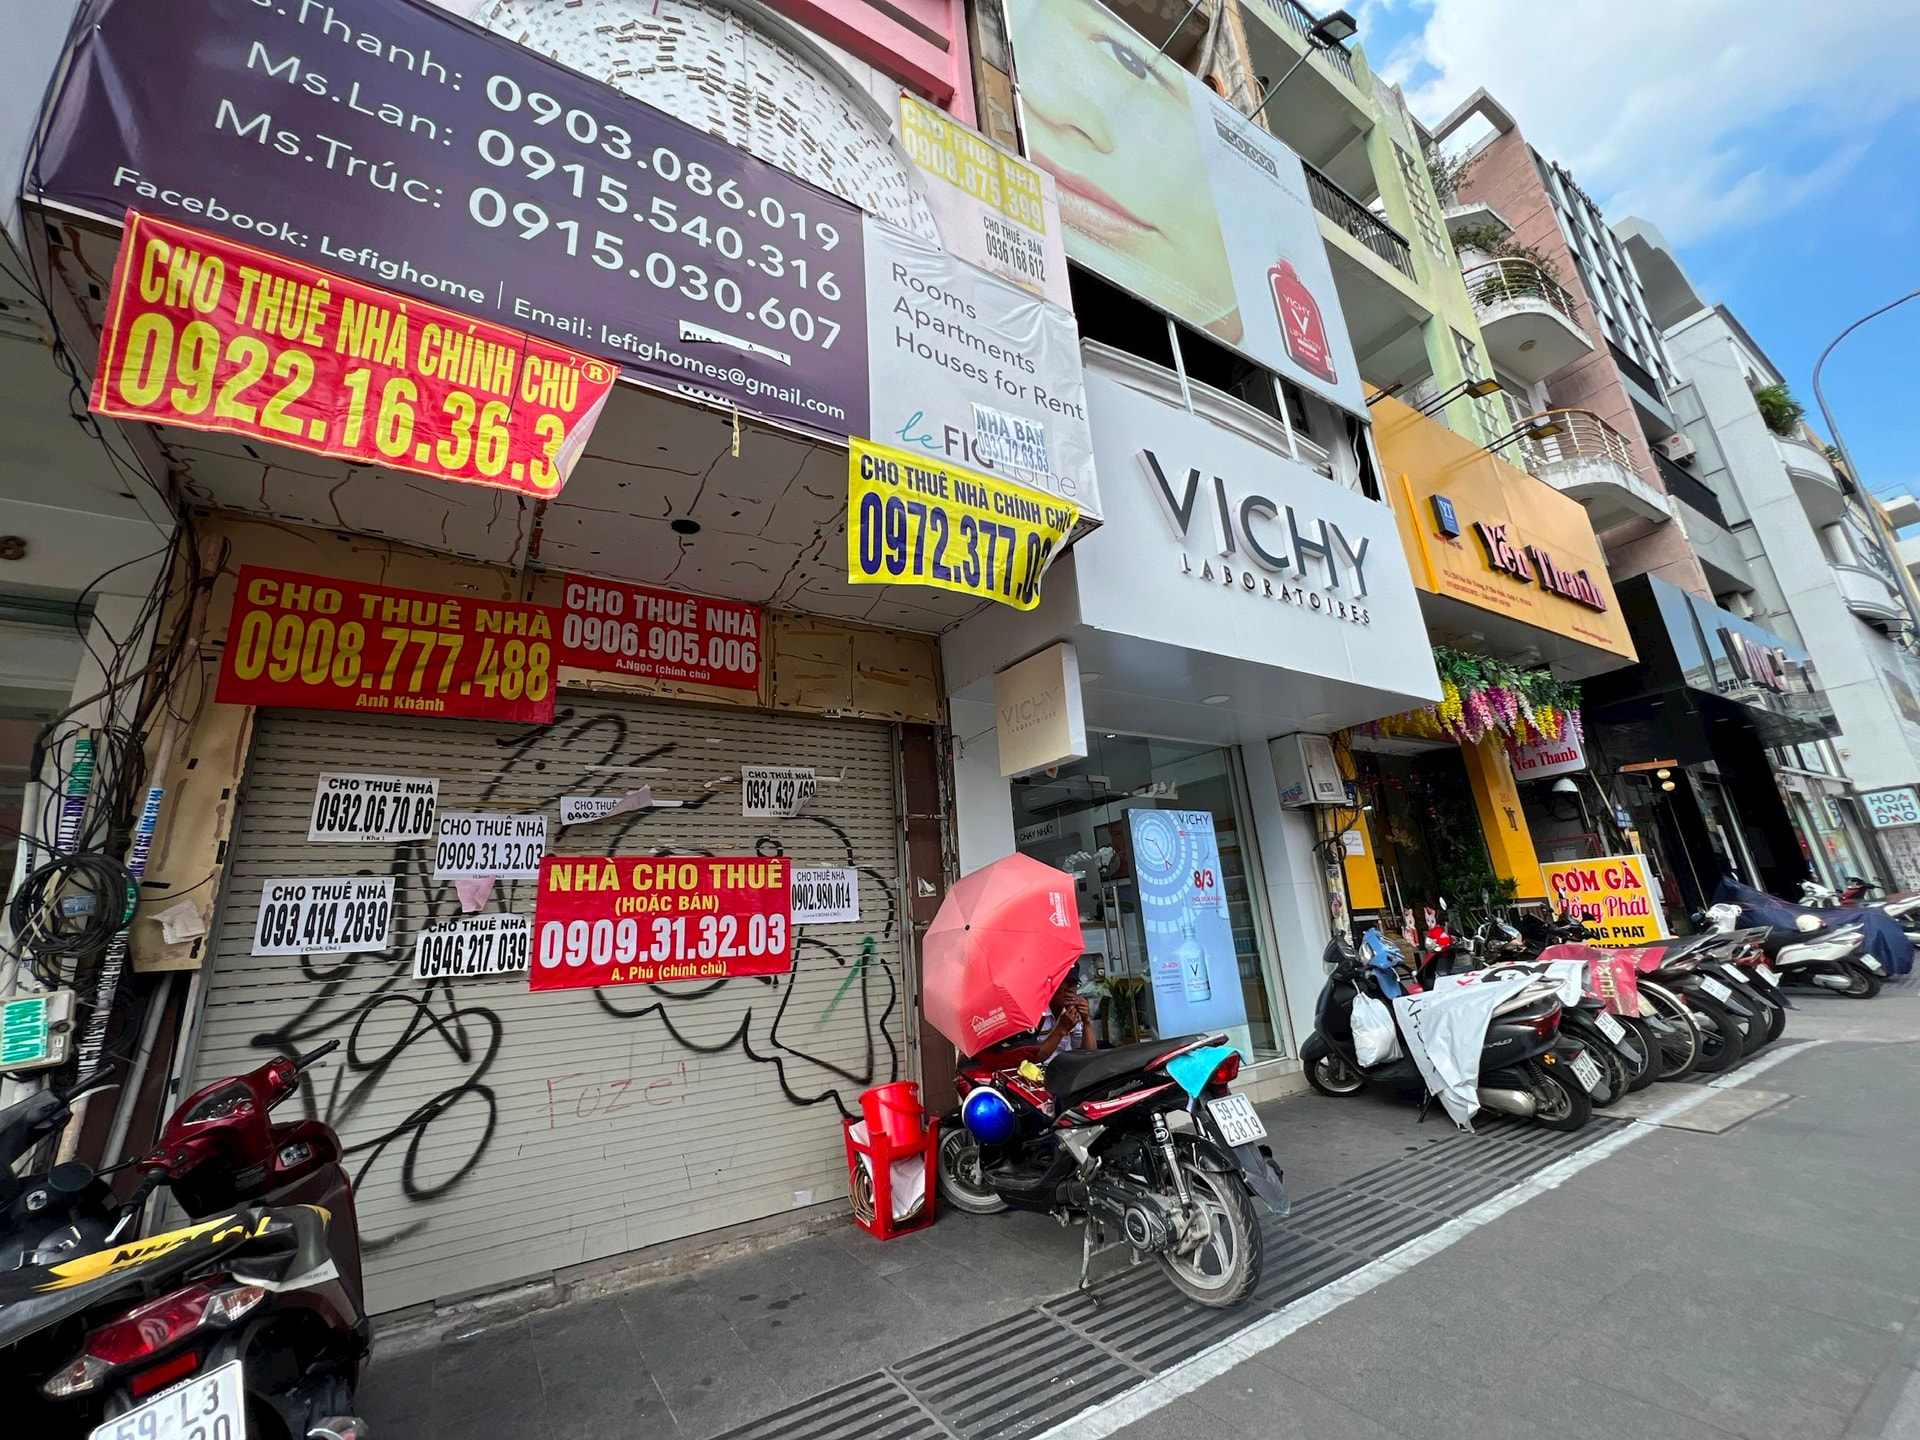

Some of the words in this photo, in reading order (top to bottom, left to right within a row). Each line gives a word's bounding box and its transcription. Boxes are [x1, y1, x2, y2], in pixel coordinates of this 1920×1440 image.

[247, 41, 453, 146] Ms.Lan:
[478, 129, 841, 300] 0915.540.316
[486, 75, 840, 252] 0903.086.019
[904, 128, 1043, 230] 0908.875.399
[214, 99, 443, 208] Ms.Trúc:
[469, 187, 841, 351] 0915.030.607
[984, 216, 1000, 235] CHO
[986, 233, 1009, 267] 0936
[113, 166, 308, 249] Facebook:
[319, 235, 486, 305] Lefighome
[514, 298, 593, 340] Email:
[601, 325, 845, 421] lefighomes@gmail.com
[892, 262, 977, 320] Rooms
[1283, 294, 1311, 316] VICHY
[139, 238, 225, 315] CHO
[236, 279, 332, 350] THUÊ
[336, 302, 407, 371] NHÀ
[417, 319, 513, 398] CHÍNH
[522, 354, 580, 412] CHỦ
[893, 296, 1035, 374] Apartments
[896, 326, 988, 385] Houses
[994, 370, 1027, 400] for
[1034, 386, 1085, 420] Rent
[977, 431, 1050, 474] 0931.72.63.63
[861, 454, 899, 485] CHO
[904, 465, 949, 499] THUÊ
[954, 481, 990, 511] NHÀ
[993, 490, 1042, 524] CHÍNH
[1135, 448, 1370, 600] VICHY
[1180, 553, 1371, 625] LABORATOIRES
[1526, 544, 1608, 613] Thanh
[248, 579, 343, 614] CHO
[358, 594, 463, 629] THUÊ
[475, 608, 553, 640] NHÀ
[566, 583, 624, 615] CHO
[633, 594, 698, 628] THUÊ
[706, 608, 757, 638] NHÀ
[234, 610, 551, 702] 0908.777.488
[563, 614, 757, 674] 0906.905.006
[615, 659, 653, 675] A.Ngọc
[656, 663, 687, 679] (chính
[689, 668, 711, 681] chủ)
[356, 694, 389, 709] Anh
[394, 695, 445, 712] Khánh
[1001, 686, 1059, 727] VICHY
[1537, 747, 1578, 767] Thanh
[328, 778, 360, 791] CHO
[364, 777, 402, 793] THUÊ
[406, 780, 434, 795] NHÀ
[748, 771, 768, 779] CHO
[316, 792, 435, 834] 0932.06.70.86
[574, 800, 593, 810] CHO
[1178, 814, 1210, 825] VICHY
[440, 818, 472, 836] CHO
[476, 815, 513, 836] THUÊ
[515, 816, 545, 837] NHÀ
[437, 841, 542, 870] 0909.31.32.03
[272, 886, 306, 902] CHO
[311, 881, 351, 901] THUÊ
[357, 880, 386, 900] NHÀ
[548, 858, 621, 892] NHÀ
[632, 864, 699, 890] CHO
[708, 859, 783, 888] THUÊ
[797, 871, 812, 882] CHO
[812, 869, 831, 881] THUÊ
[1193, 869, 1214, 891] 8/3
[1551, 868, 1601, 892] CƠM
[1604, 861, 1642, 889] GÀ
[614, 895, 673, 917] (HOẶC
[678, 891, 720, 913] BÁN)
[792, 882, 851, 910] 0902.980.014
[1604, 894, 1650, 917] Phát
[260, 901, 389, 947] 093.414.2839
[428, 921, 457, 934] CHO
[462, 916, 497, 932] THUÊ
[500, 915, 527, 931] NHÀ
[539, 913, 787, 969] 0909.31.32.03
[1611, 925, 1646, 939] PHAT
[611, 968, 626, 981] A.
[629, 965, 654, 980] Phú
[658, 965, 698, 979] (chính
[701, 960, 728, 977] chủ)
[1214, 1096, 1247, 1121] 59-L1
[1222, 1116, 1263, 1143] 238.19
